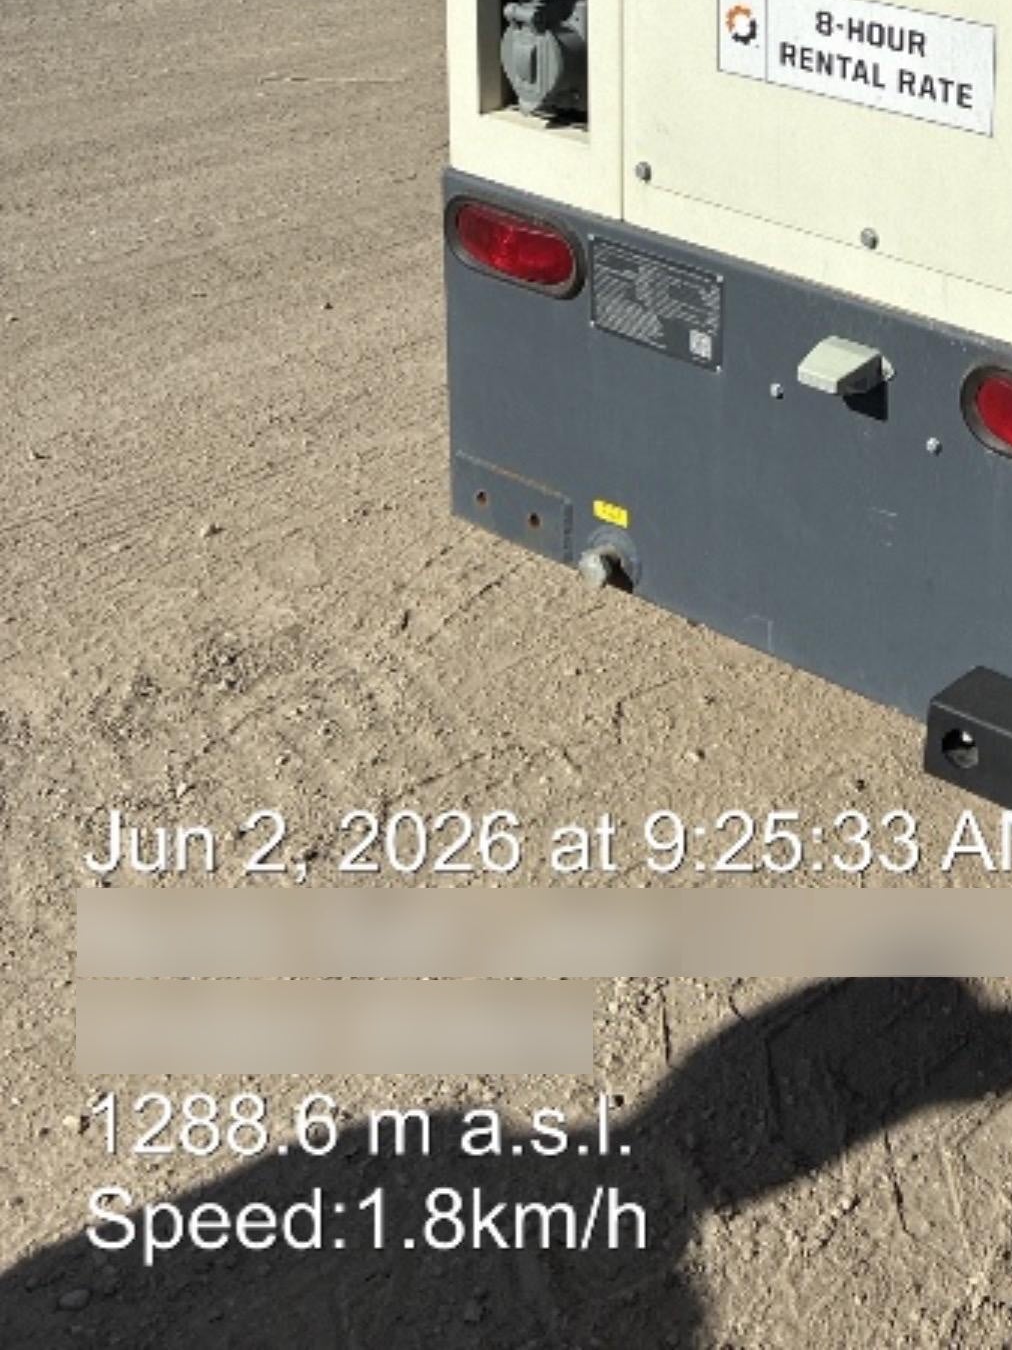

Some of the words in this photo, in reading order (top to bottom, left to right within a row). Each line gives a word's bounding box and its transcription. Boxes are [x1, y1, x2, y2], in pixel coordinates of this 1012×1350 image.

[815, 11, 926, 58] 8-HOUR
[779, 41, 886, 90] RENTAL
[898, 68, 973, 110] RATE
